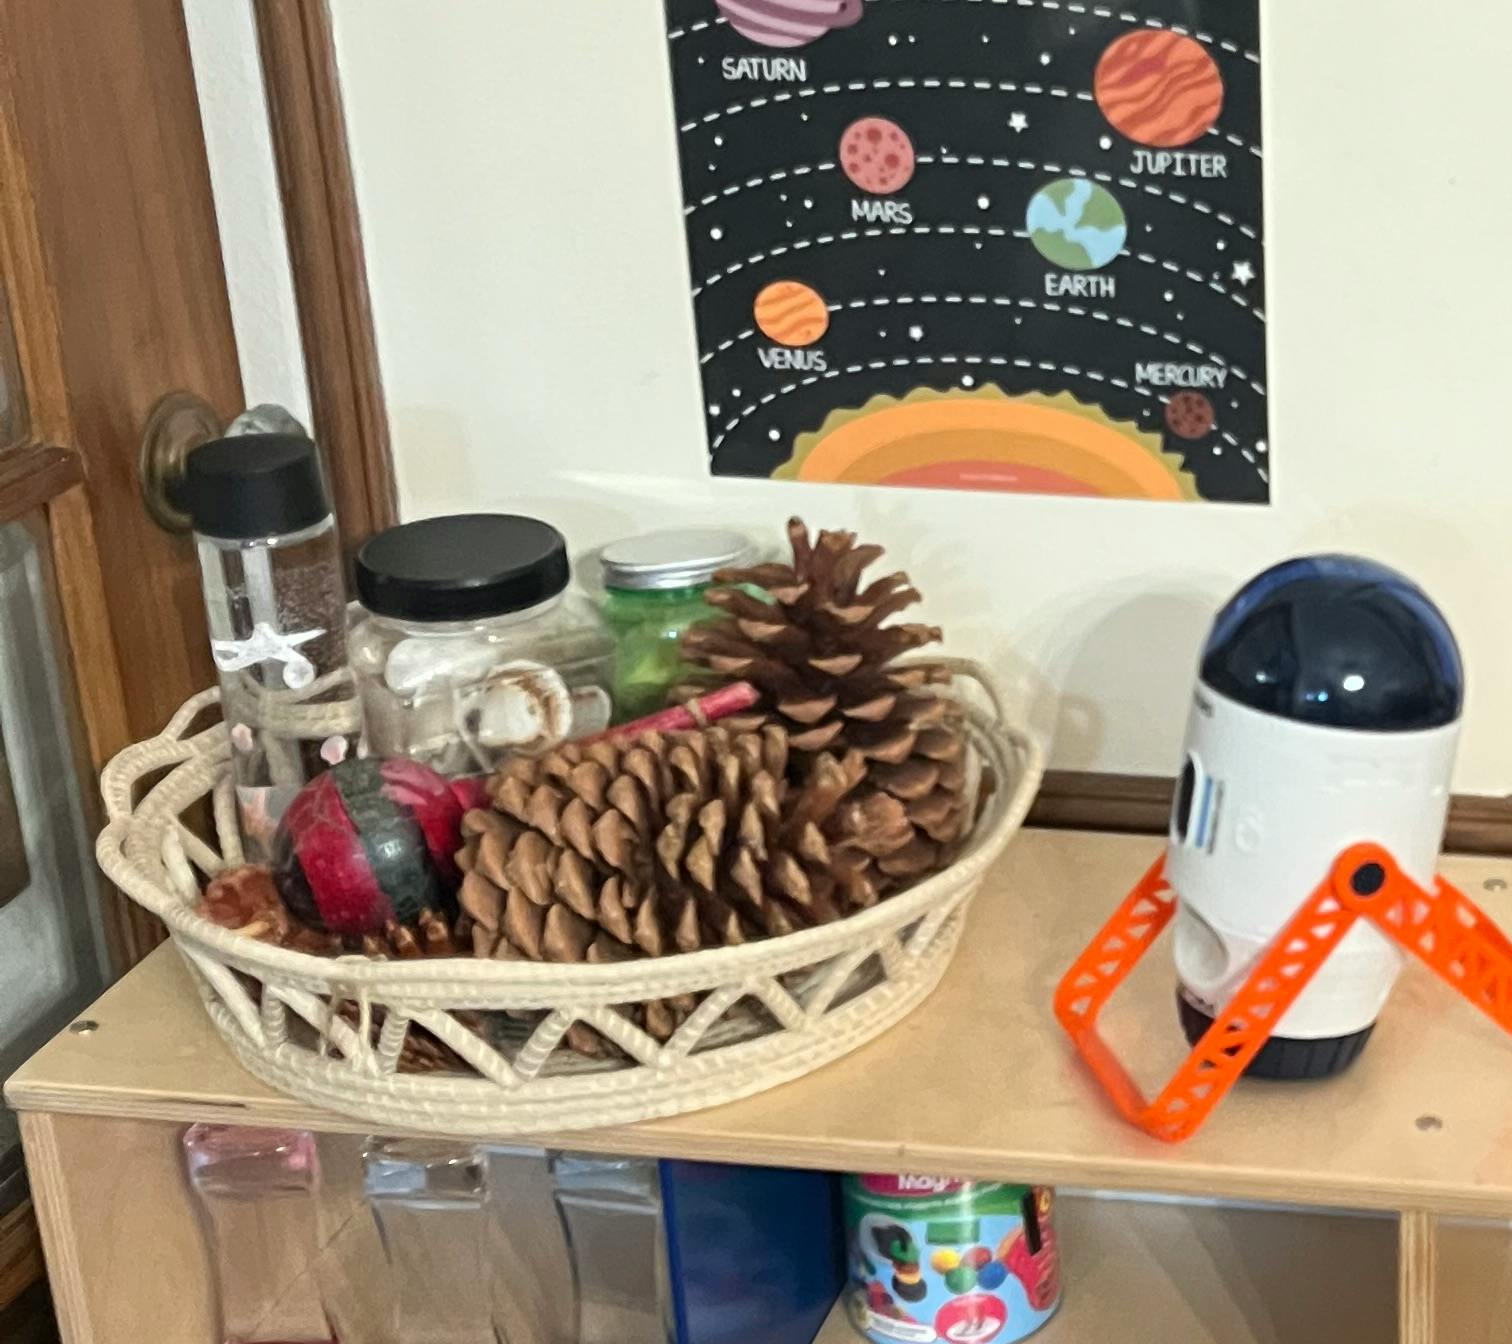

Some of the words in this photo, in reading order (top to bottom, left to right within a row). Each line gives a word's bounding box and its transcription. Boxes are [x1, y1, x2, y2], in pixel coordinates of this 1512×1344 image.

[722, 57, 807, 82] SATURN
[1130, 150, 1228, 178] JUPITER
[852, 200, 913, 224] MARS
[1045, 274, 1115, 298] EARTH
[758, 348, 826, 372] VENUS
[1135, 363, 1228, 389] MERCURY
